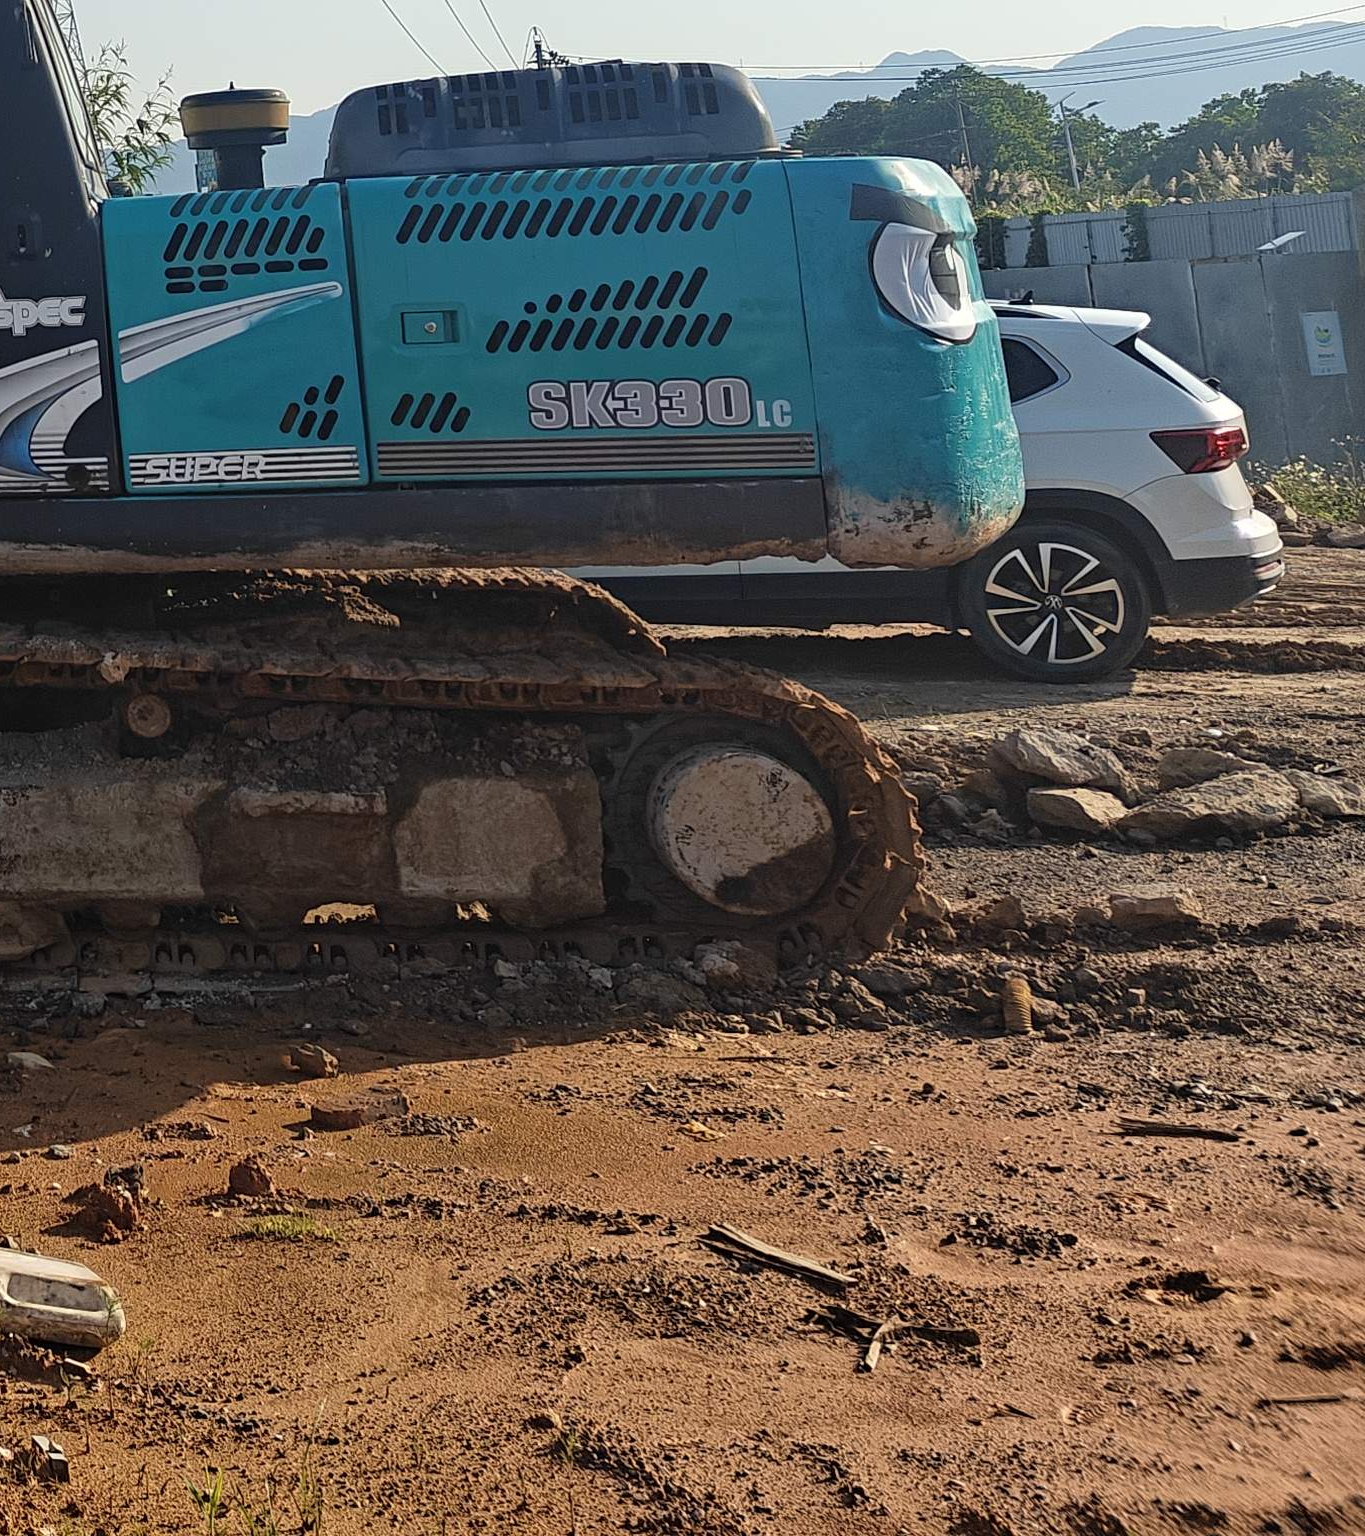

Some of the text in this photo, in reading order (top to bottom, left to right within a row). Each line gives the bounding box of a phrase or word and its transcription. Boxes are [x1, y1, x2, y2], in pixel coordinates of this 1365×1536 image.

[527, 376, 793, 430] SK330 LC
[144, 454, 267, 484] SUPER
